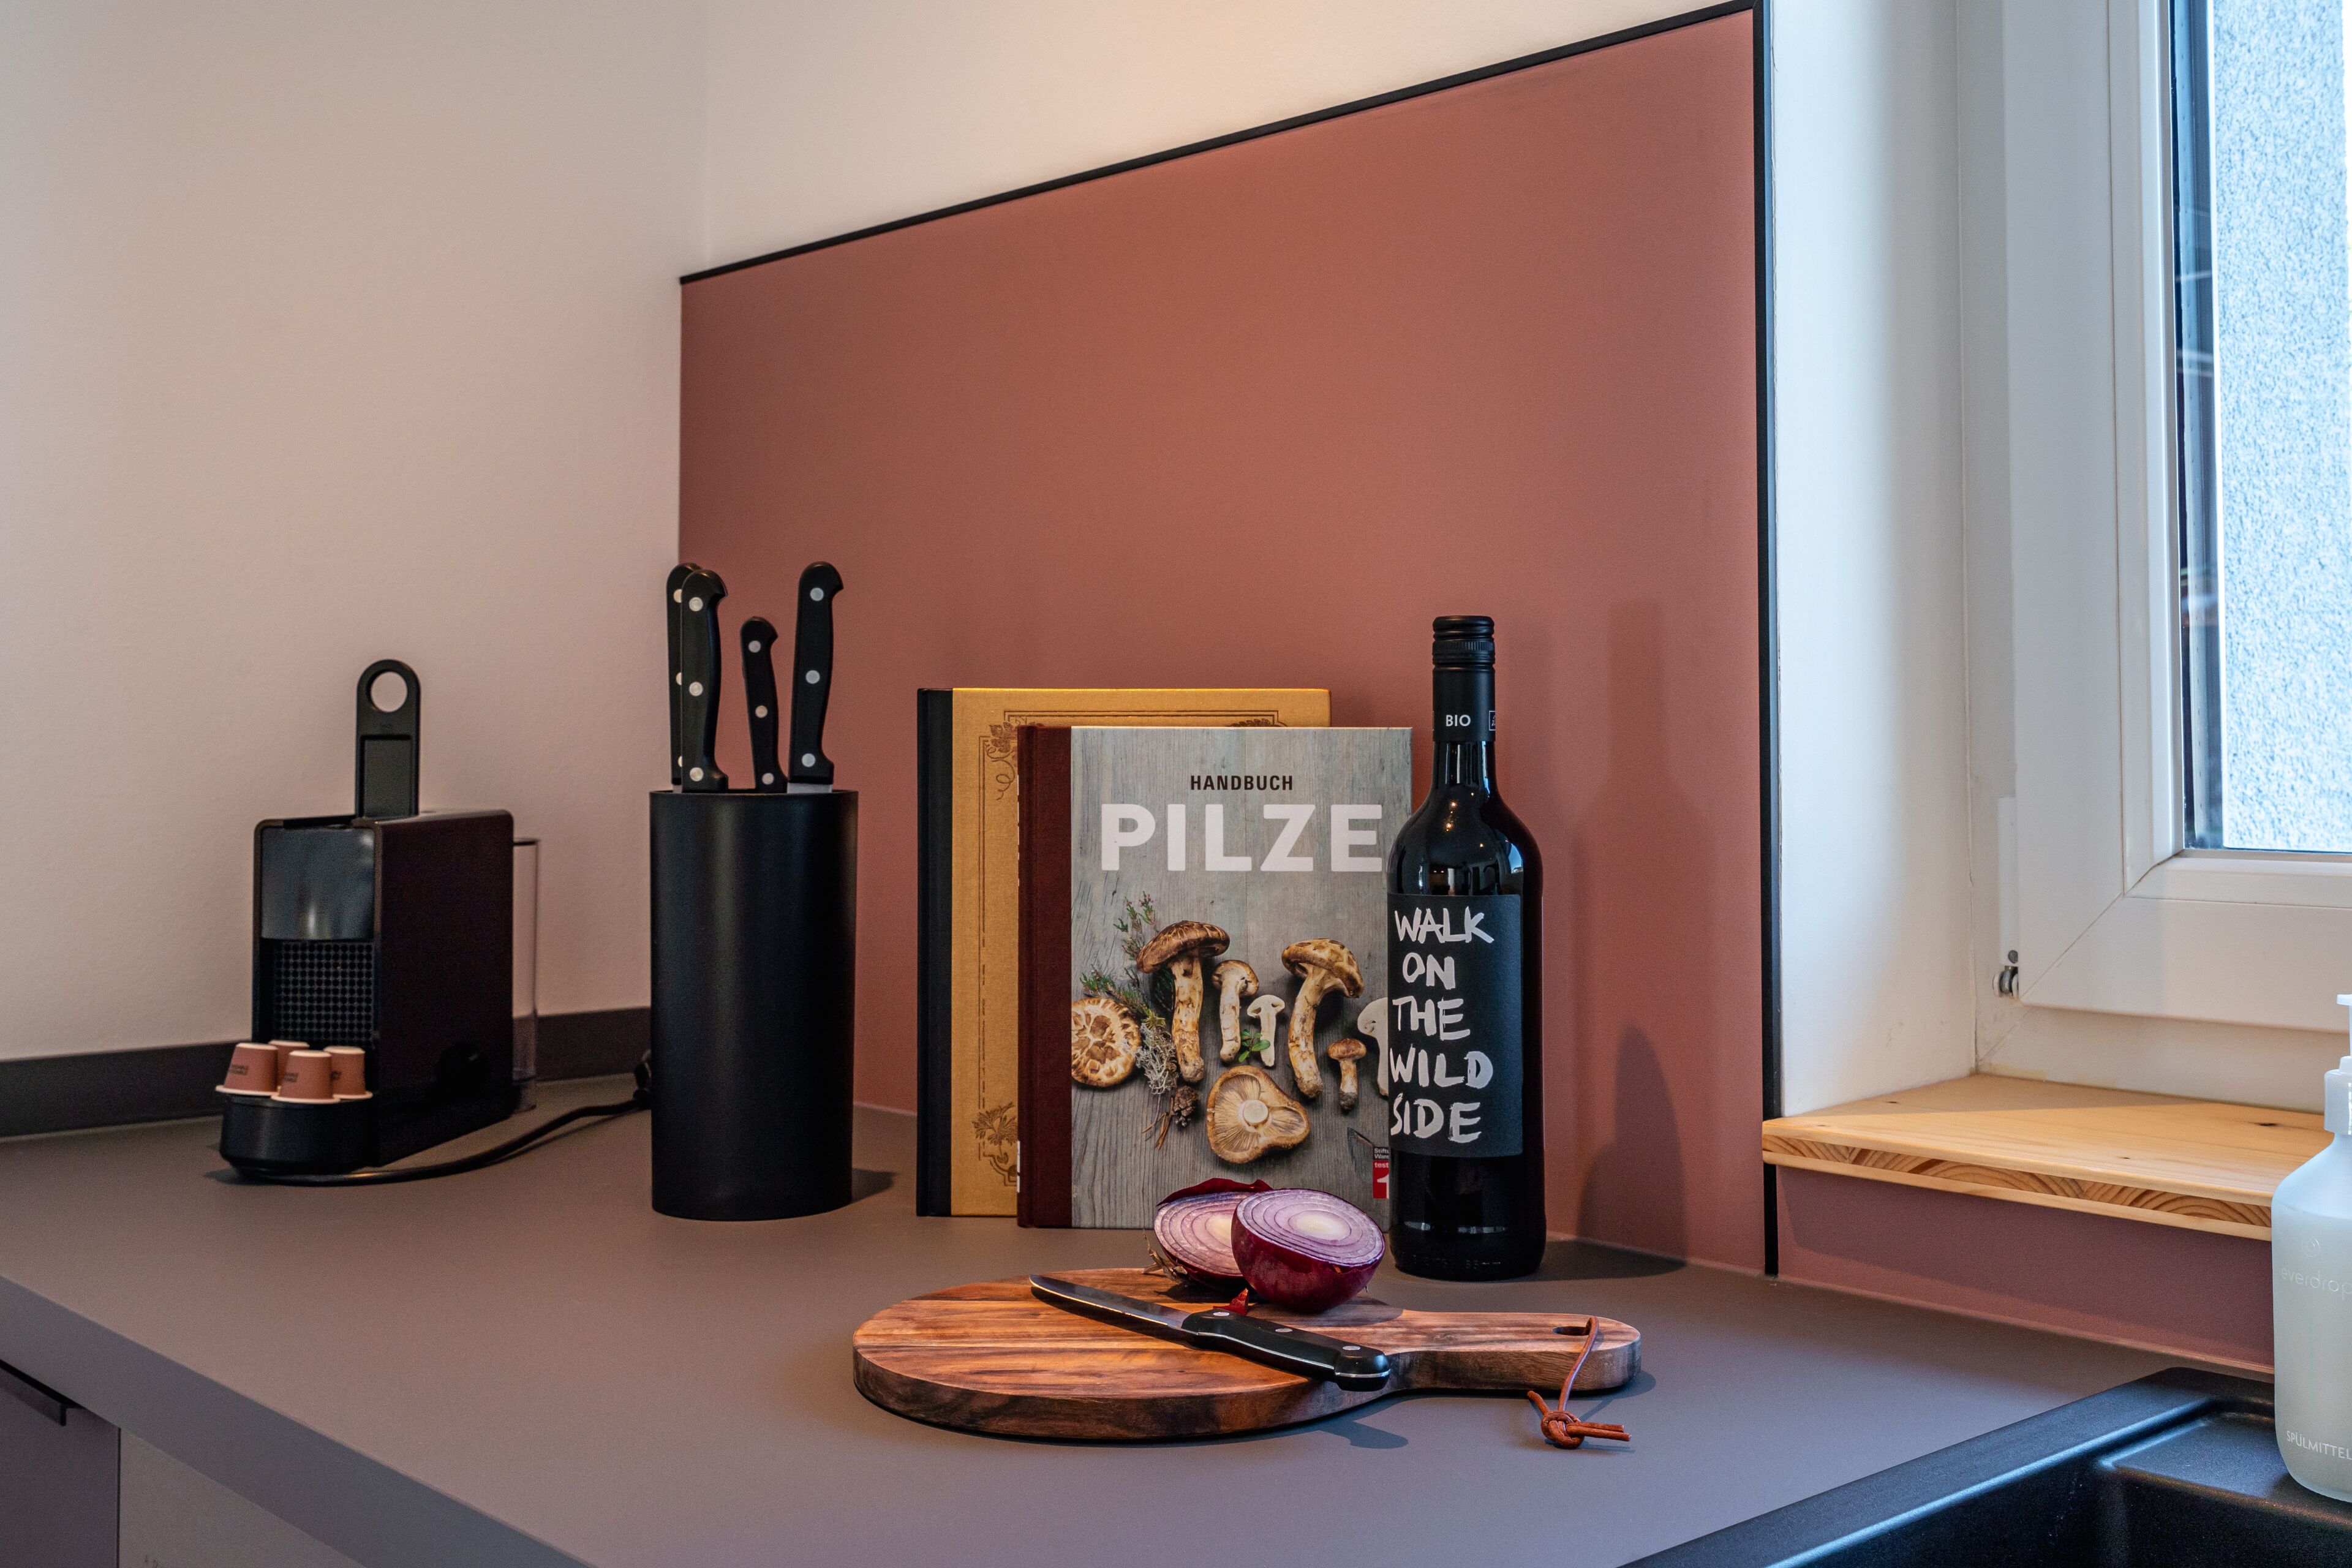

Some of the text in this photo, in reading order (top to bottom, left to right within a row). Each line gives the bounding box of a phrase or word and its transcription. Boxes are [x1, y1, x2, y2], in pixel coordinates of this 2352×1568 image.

[1446, 714, 1471, 727] BIO
[1191, 775, 1292, 791] HANDBUCH
[1102, 804, 1382, 872] PILZE
[1395, 907, 1494, 944] WALK
[1403, 952, 1455, 990] ON
[1392, 996, 1470, 1041] THE
[1390, 1044, 1493, 1089] WILD
[1390, 1093, 1482, 1143] SIDE
[2281, 1268, 2352, 1301] everdrop
[2286, 1430, 2352, 1460] SPÜLMITTEL
